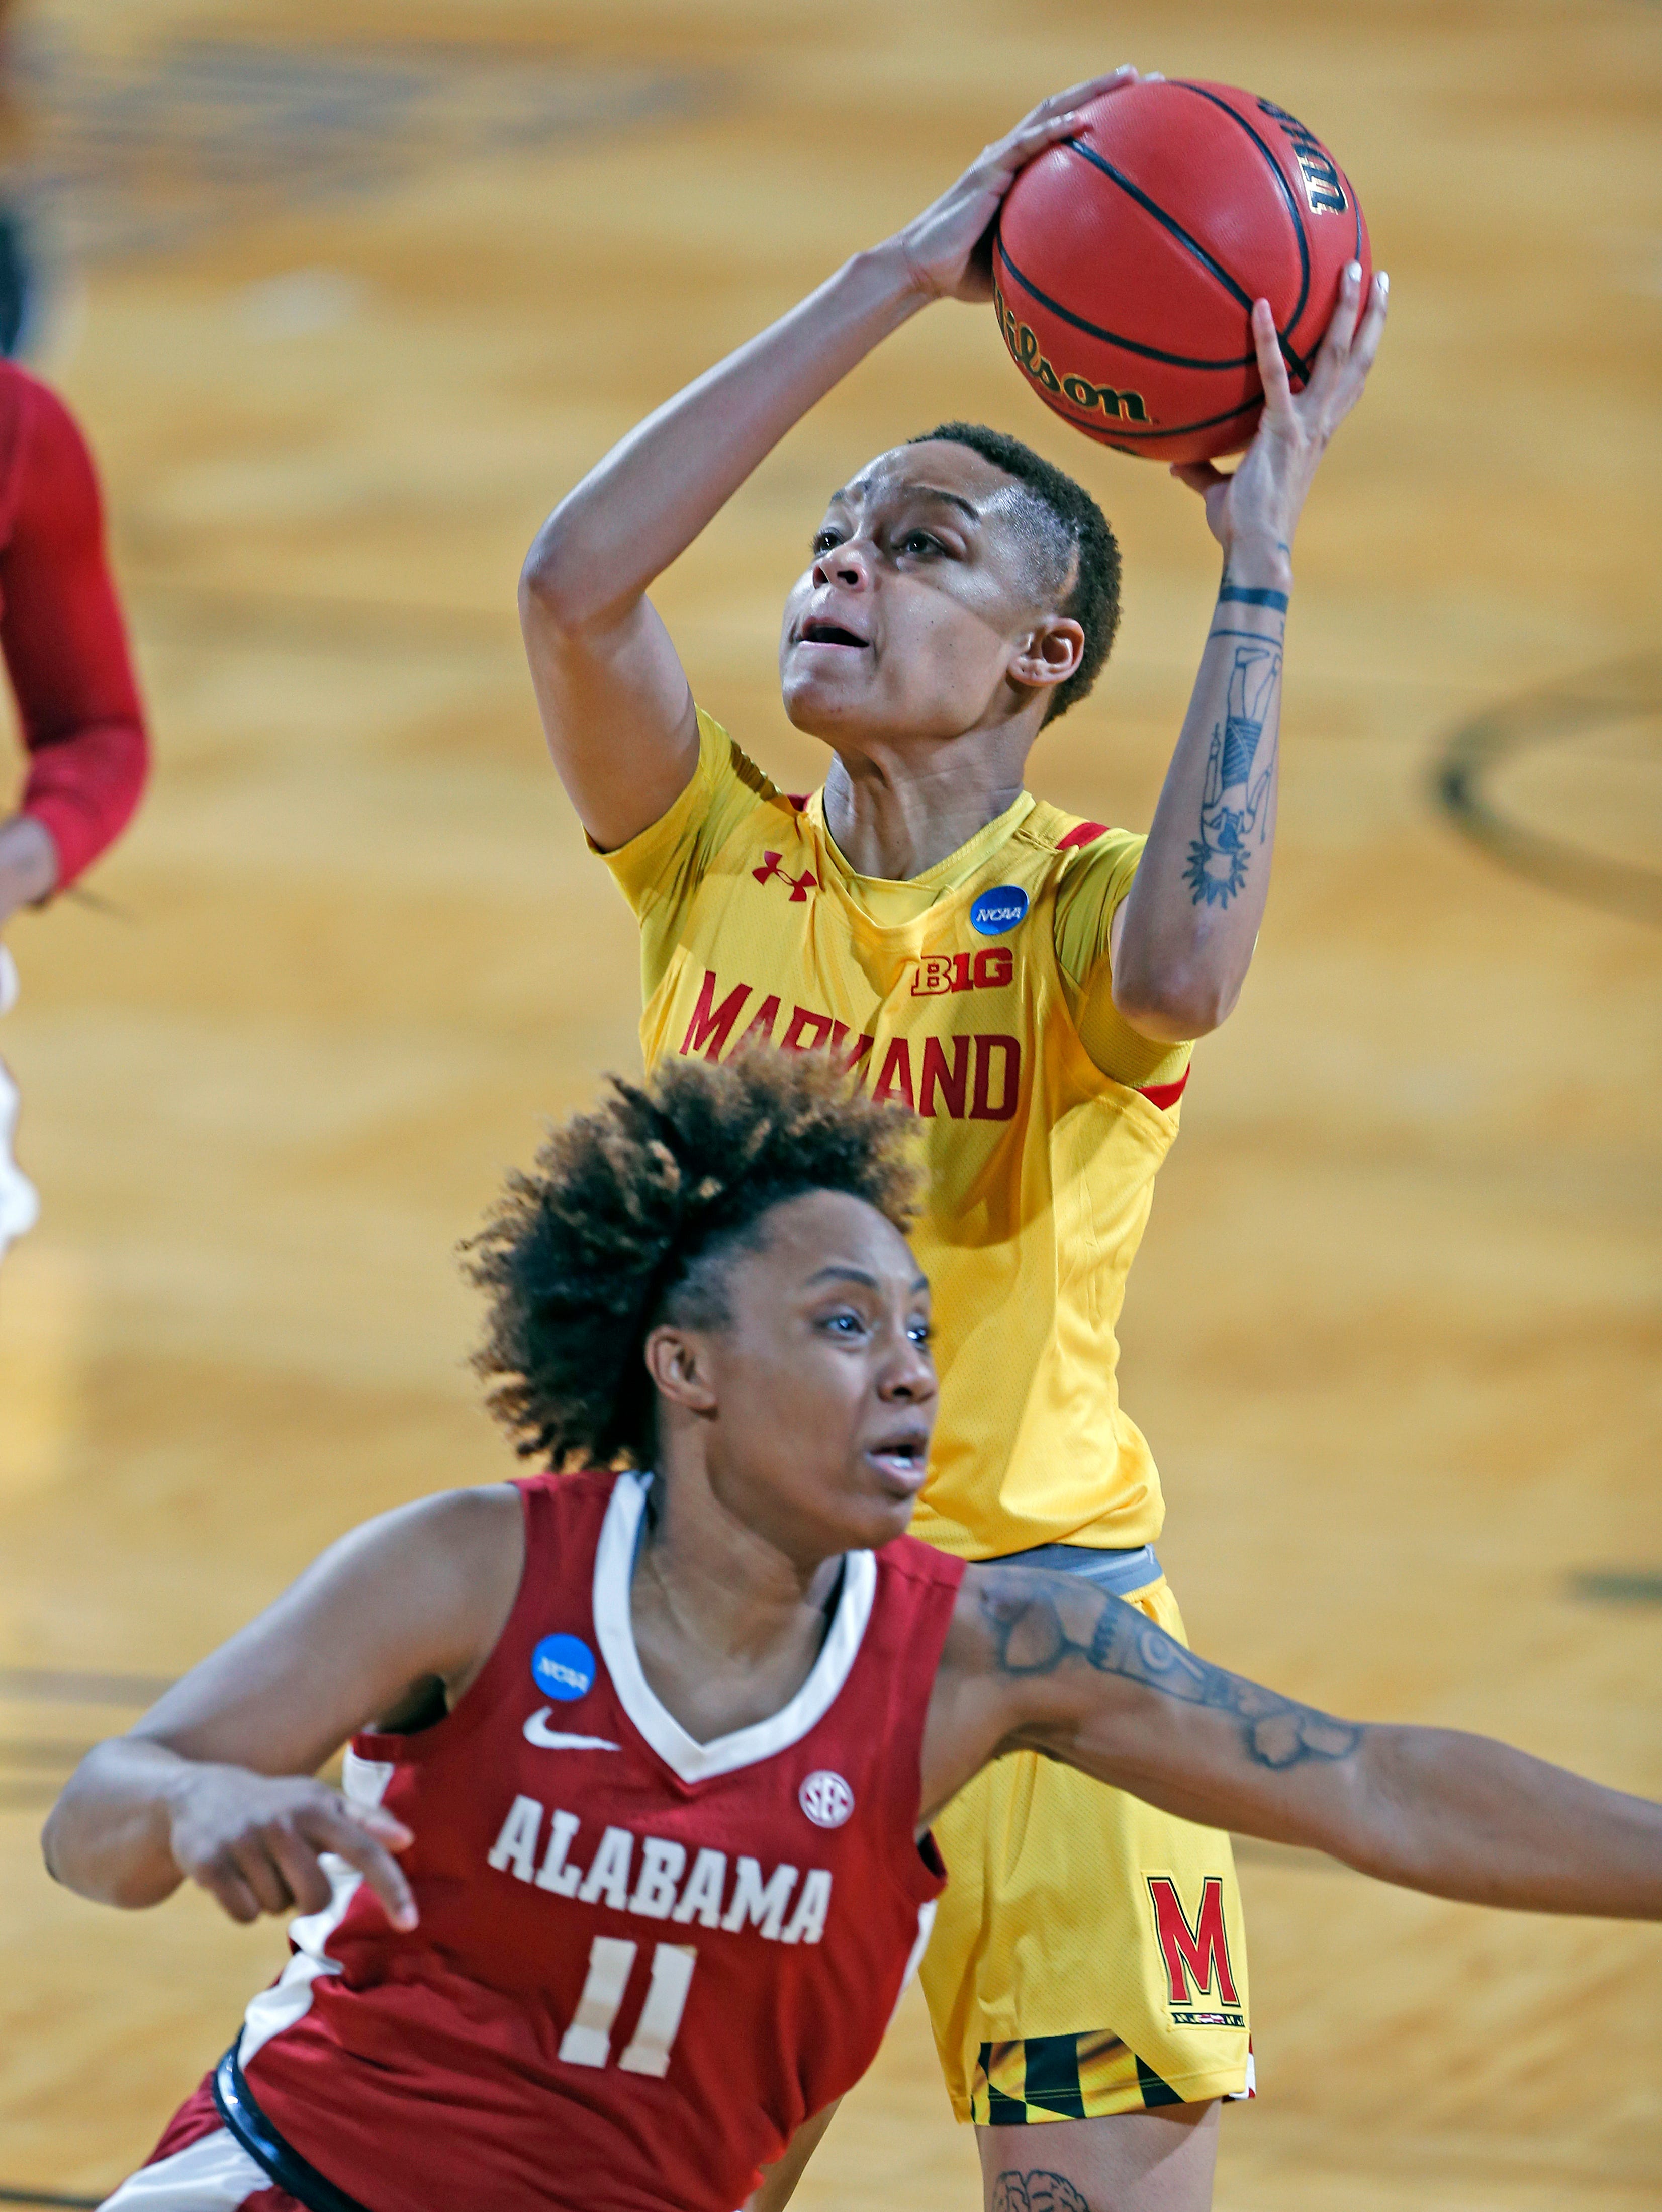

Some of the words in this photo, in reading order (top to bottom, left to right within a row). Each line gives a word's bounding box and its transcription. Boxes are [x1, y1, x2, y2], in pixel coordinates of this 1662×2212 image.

[1257, 96, 1349, 215] Wil
[976, 907, 1022, 922] NCAA
[680, 970, 1021, 1122] MARYAND
[537, 1656, 590, 1694] NCAA
[801, 1776, 851, 1821] SEC
[488, 1794, 833, 1944] ALABAMA
[1147, 1877, 1241, 2007] M
[558, 1936, 698, 2078] 11
